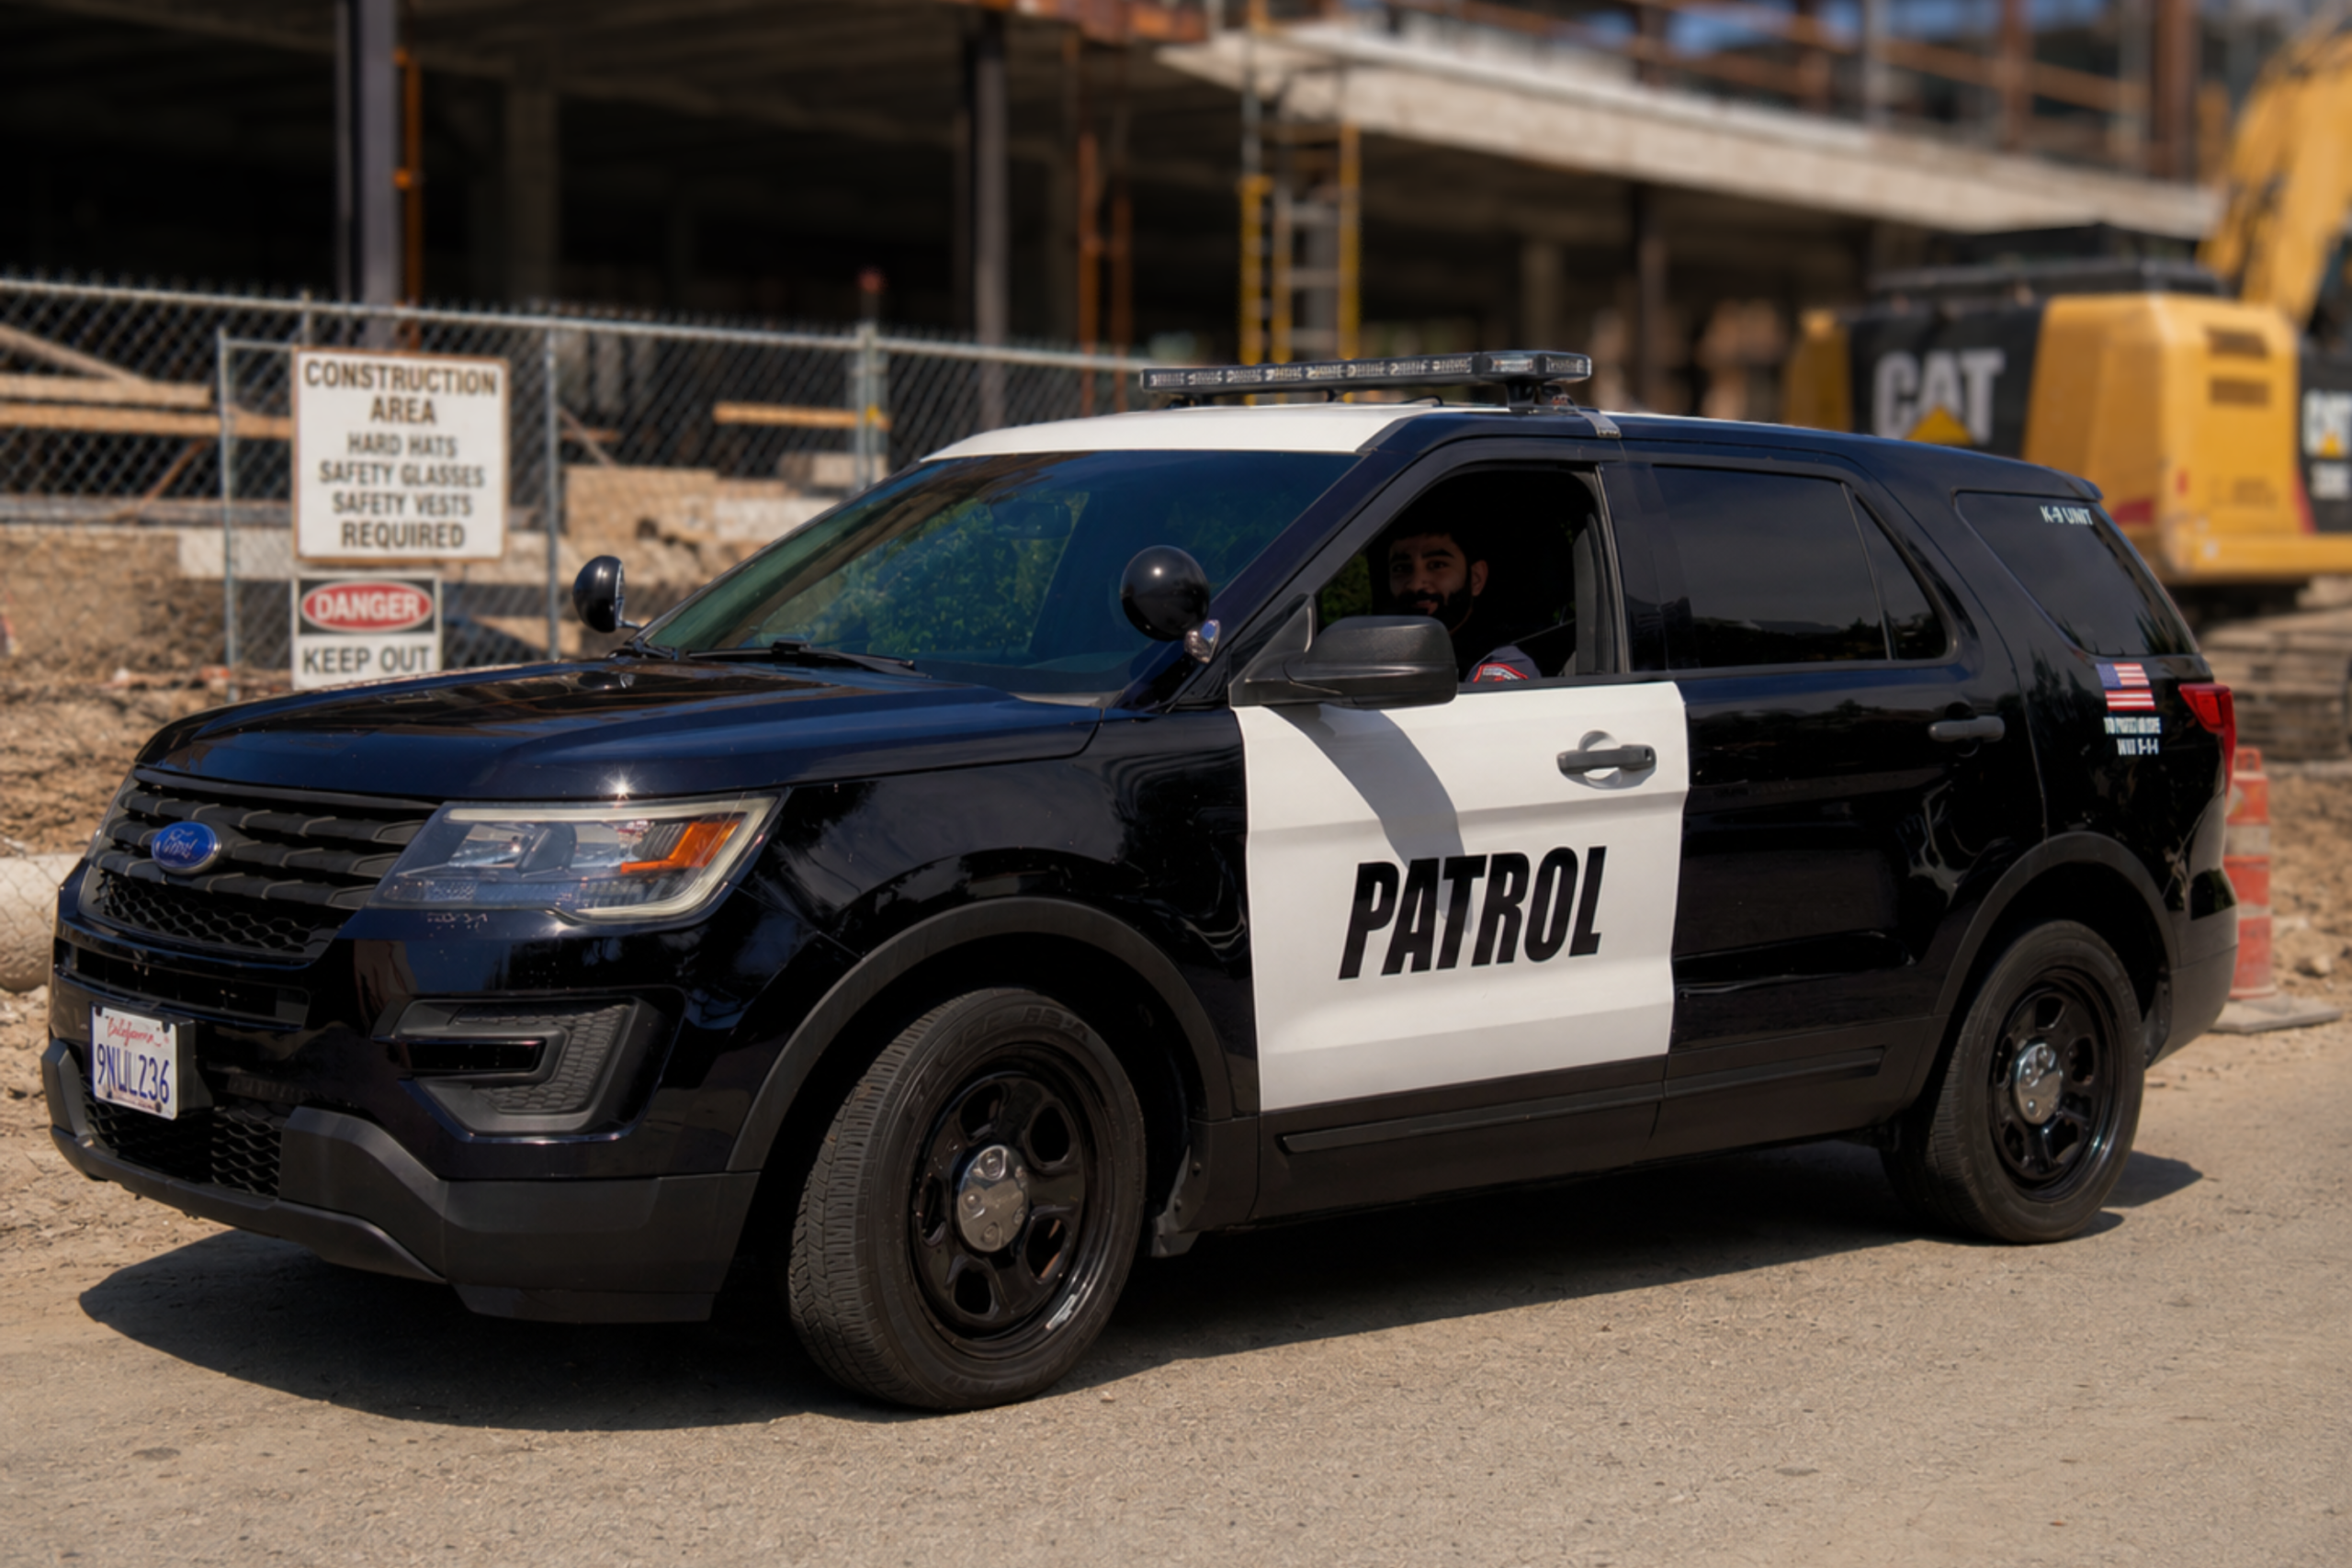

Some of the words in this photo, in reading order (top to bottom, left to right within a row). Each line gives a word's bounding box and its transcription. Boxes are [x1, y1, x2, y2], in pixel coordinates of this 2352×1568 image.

[305, 359, 497, 396] CONSTRUCTION
[370, 397, 437, 424] AREA
[1873, 349, 2004, 445] CAT
[347, 433, 402, 456] HARD
[408, 435, 457, 458] HATS
[319, 461, 393, 486] SAFETY
[401, 464, 485, 488] GLASSES
[333, 491, 406, 514] SAFETY
[414, 494, 473, 517] VESTS
[2062, 506, 2094, 525] UNIT
[342, 522, 466, 548] REQUIRED
[314, 592, 421, 622] DANGER
[302, 647, 371, 674] KEEP
[379, 646, 432, 672] OUT
[1339, 845, 1607, 980] PATROL
